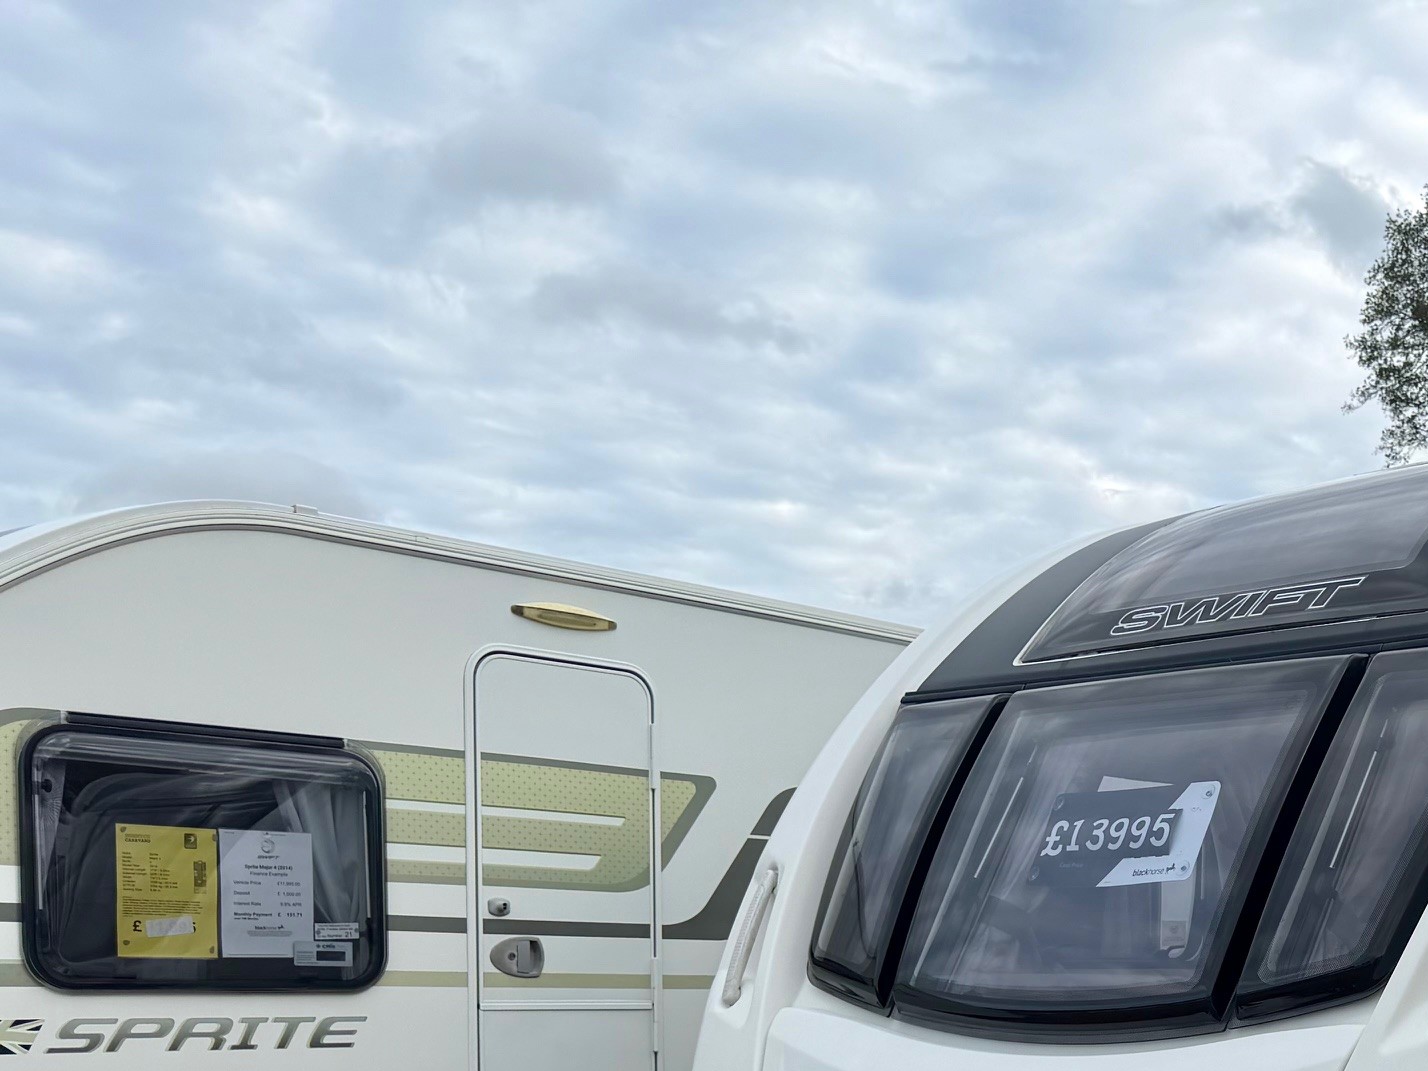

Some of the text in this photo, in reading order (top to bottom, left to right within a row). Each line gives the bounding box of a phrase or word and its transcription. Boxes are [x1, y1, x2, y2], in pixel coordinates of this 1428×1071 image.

[1110, 575, 1369, 636] SWIFT
[1040, 813, 1176, 857] £13995
[132, 920, 142, 932] £
[43, 1015, 368, 1055] SPRITE
